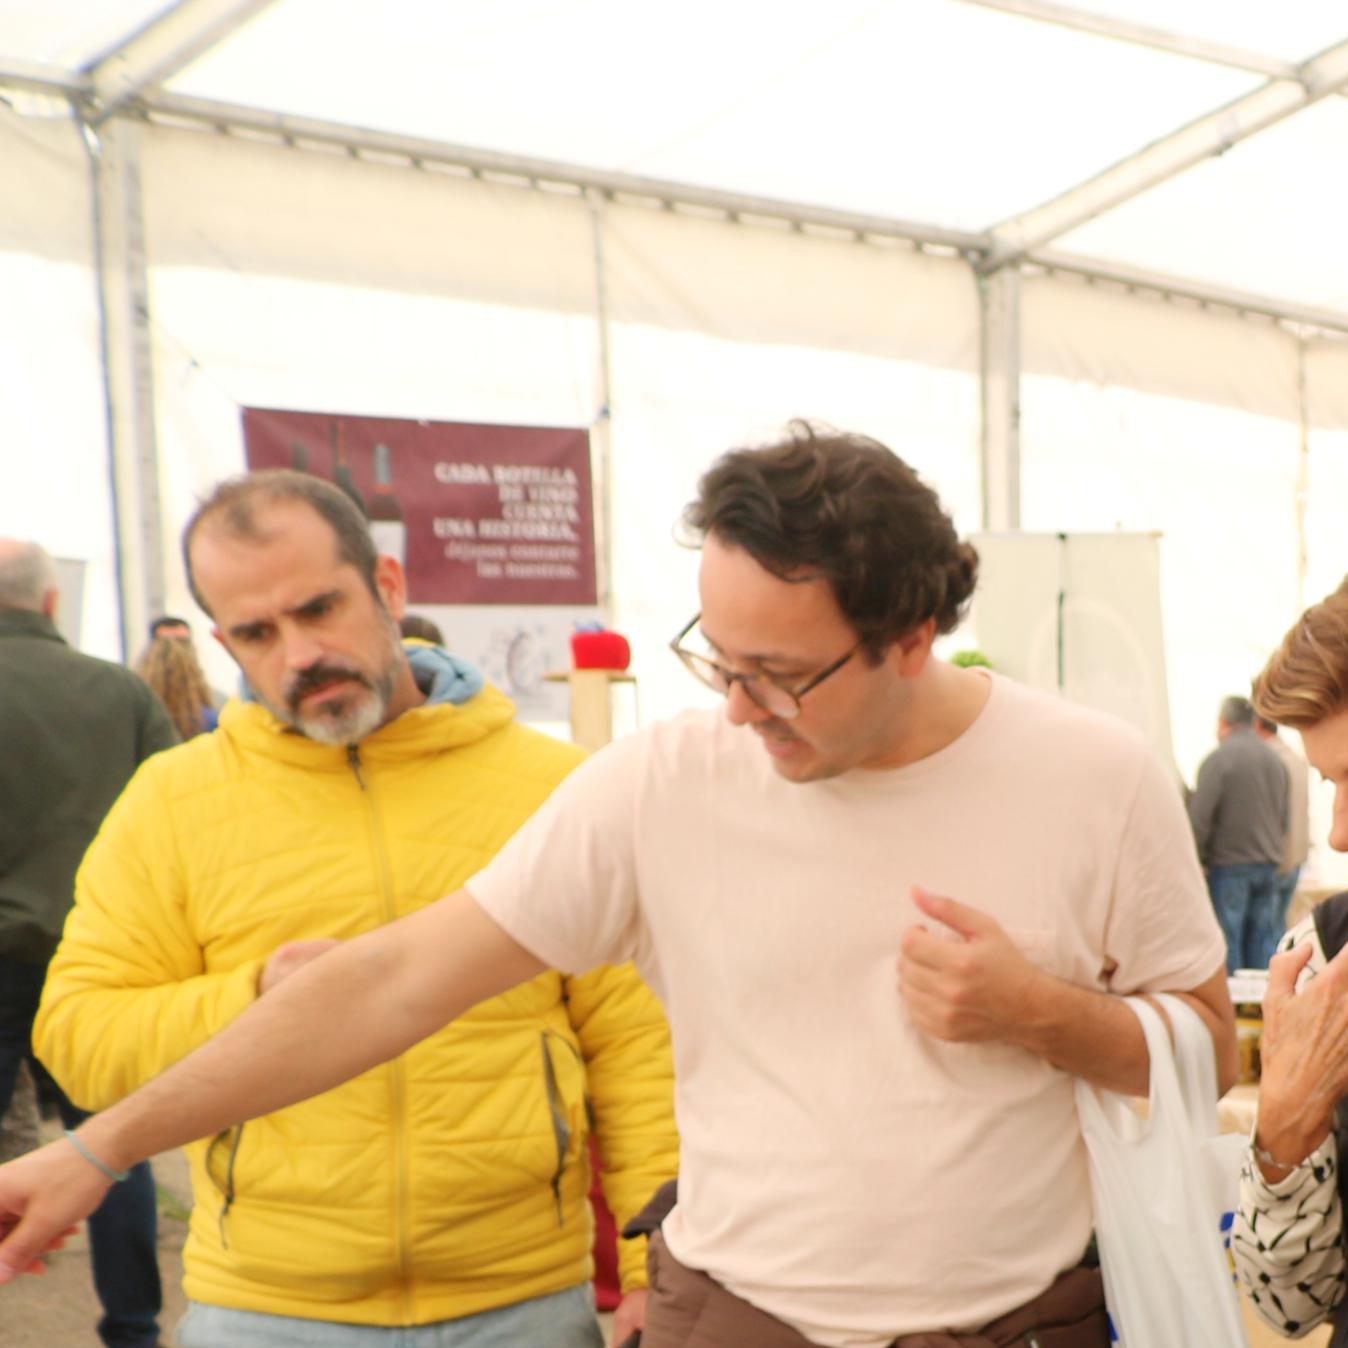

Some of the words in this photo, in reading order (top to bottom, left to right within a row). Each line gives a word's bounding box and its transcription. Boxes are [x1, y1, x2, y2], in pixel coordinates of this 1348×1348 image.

[434, 462, 491, 484] CADA
[493, 464, 577, 485] BOTELLA
[499, 485, 524, 501] DE
[528, 486, 578, 503] VINO
[502, 503, 579, 523] CUENTA
[433, 518, 476, 539] UNA
